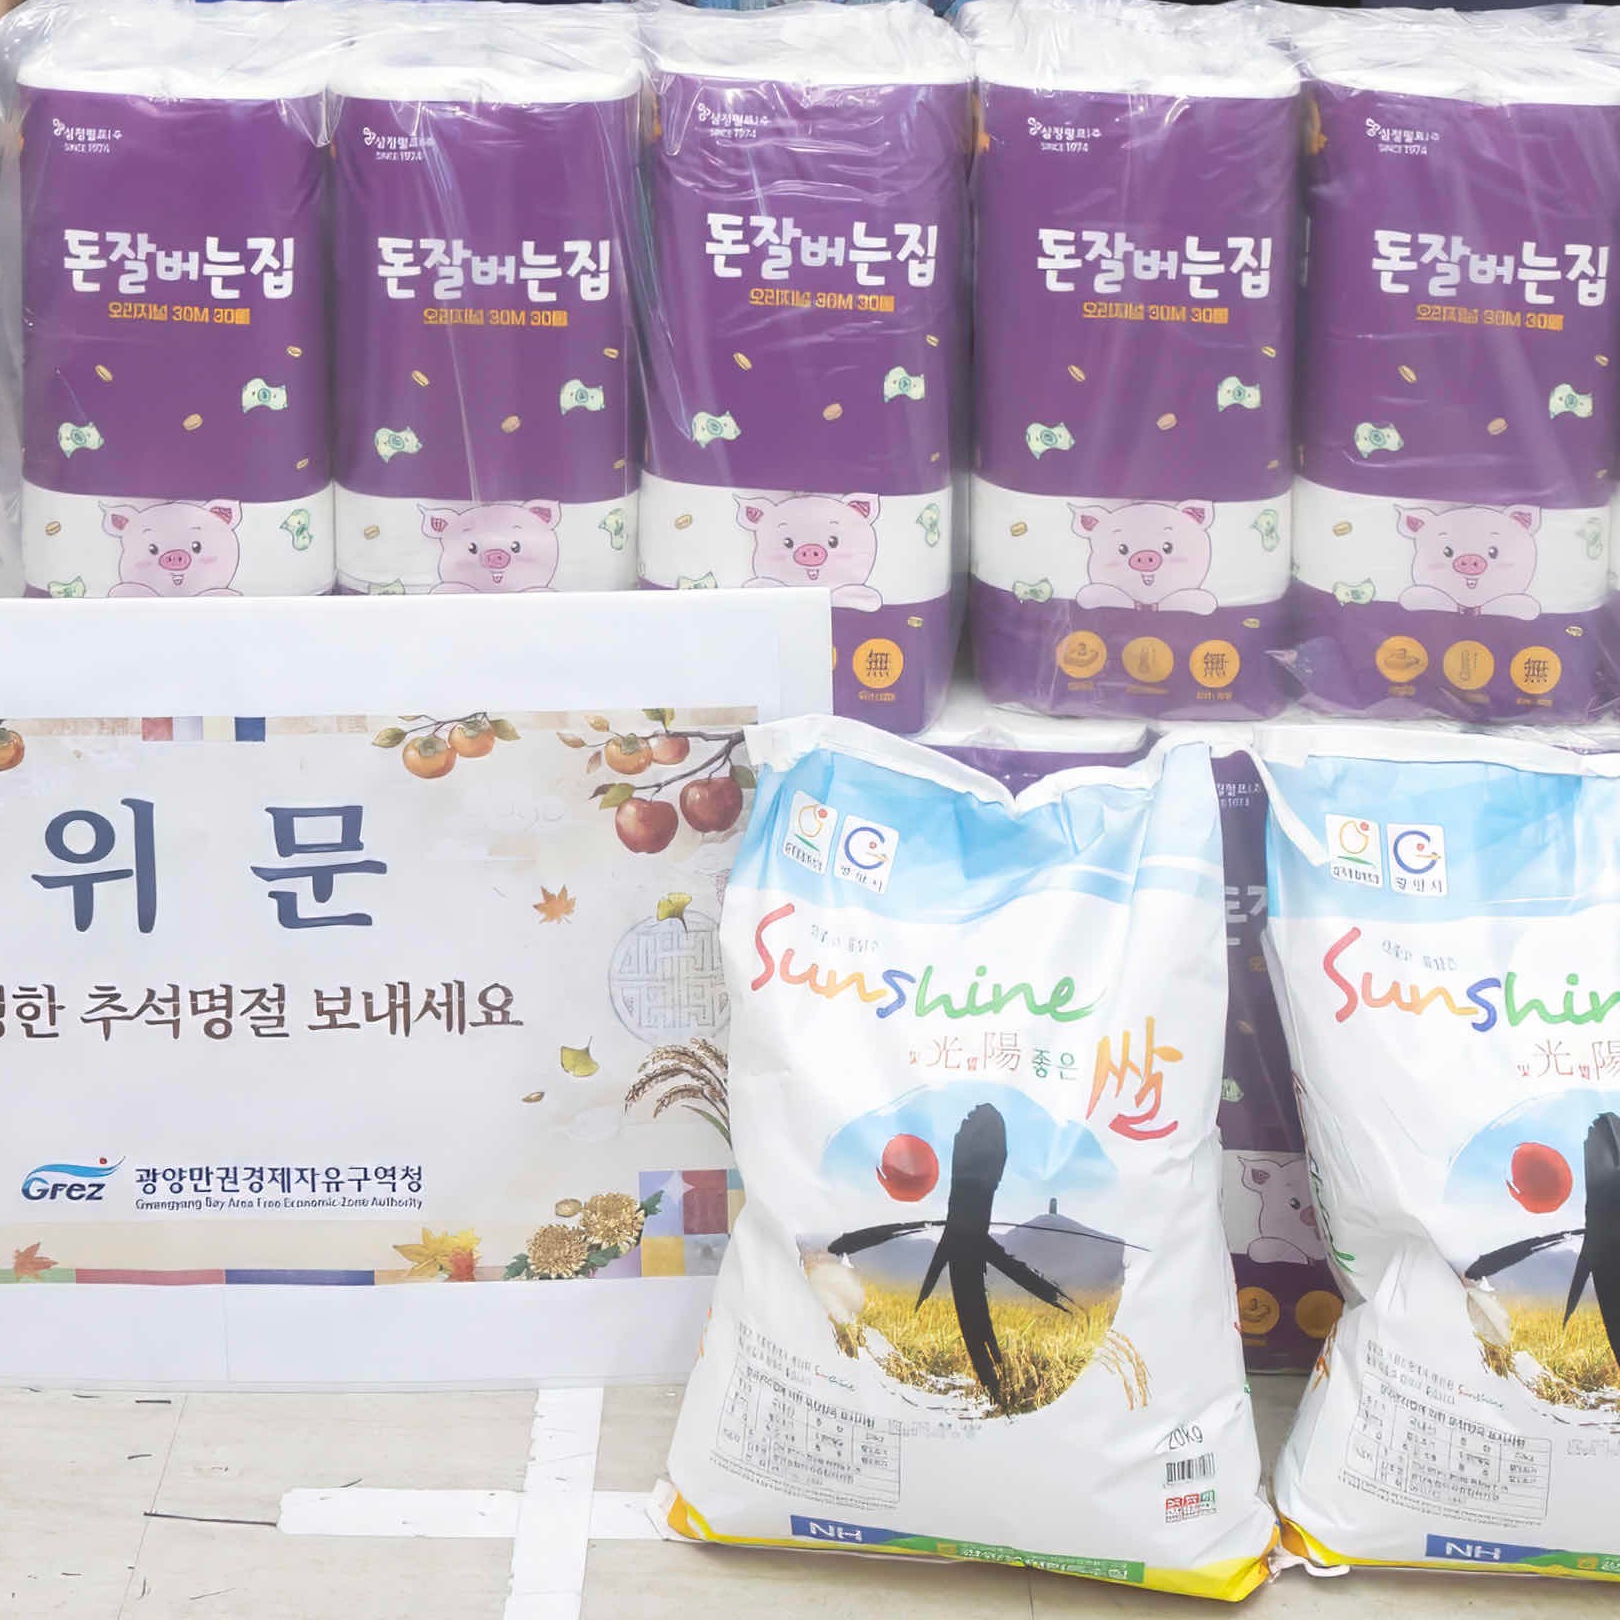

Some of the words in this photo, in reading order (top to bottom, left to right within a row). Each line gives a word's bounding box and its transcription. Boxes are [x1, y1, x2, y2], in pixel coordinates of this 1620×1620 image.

[64, 229, 294, 300] 돈잘버는집
[378, 236, 611, 303] 돈잘버는집
[705, 212, 939, 288] 돈잘버는집
[1036, 228, 1273, 300] 돈잘버는집
[1372, 229, 1610, 307] 돈잘버는집
[31, 797, 158, 935] 위
[249, 804, 388, 930] 문
[750, 902, 1107, 1023] Sunshine
[80, 982, 291, 1042] 추석명절
[307, 979, 525, 1037] 보내세요
[1032, 1048, 1079, 1080] 좋은
[1085, 1015, 1183, 1141] 쌀
[135, 1165, 423, 1195] 광양만권경제자유구역청
[1445, 1540, 1502, 1562] NH
